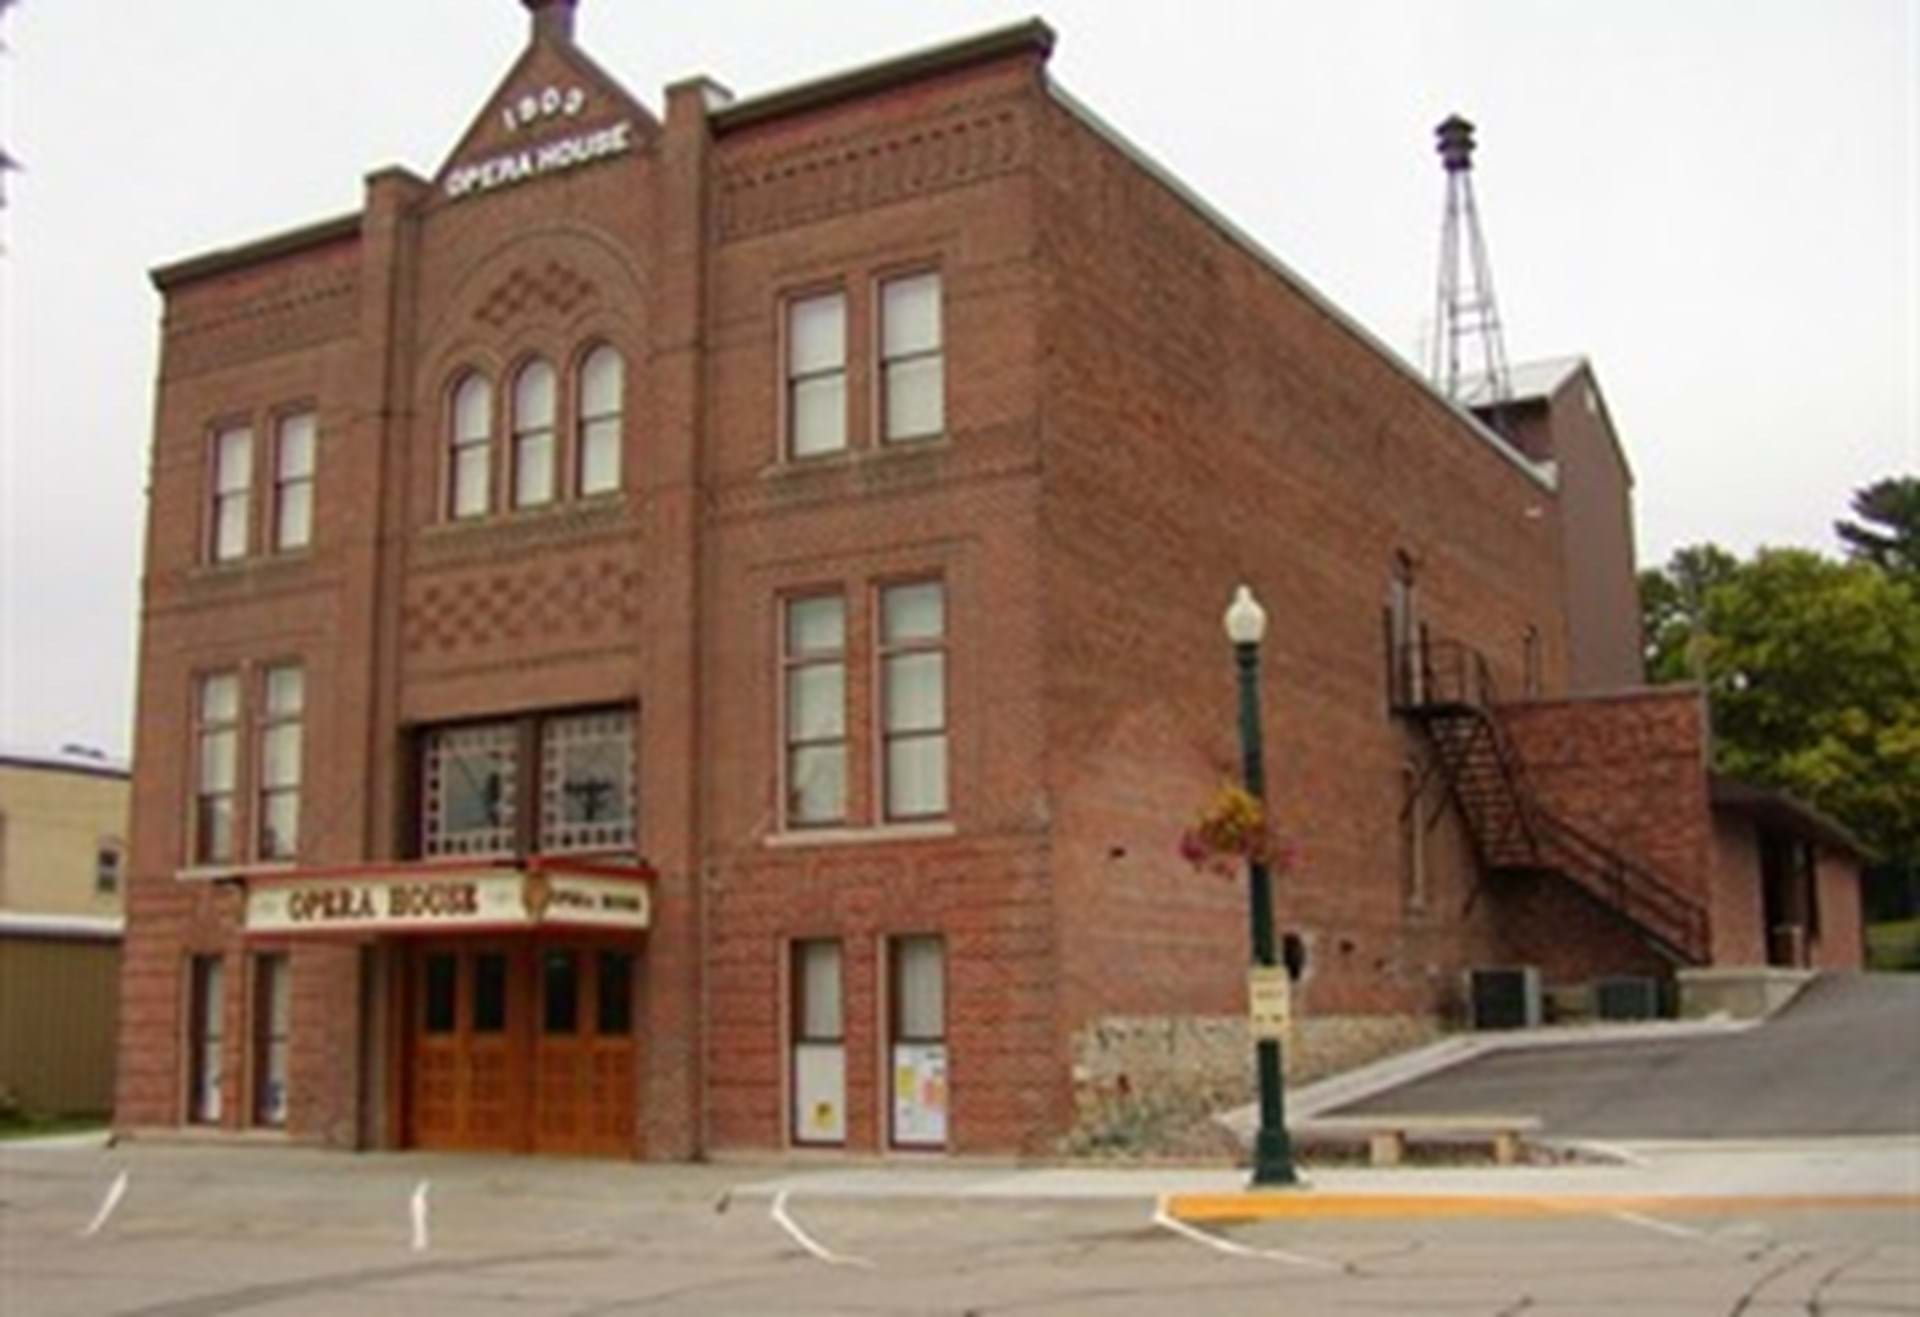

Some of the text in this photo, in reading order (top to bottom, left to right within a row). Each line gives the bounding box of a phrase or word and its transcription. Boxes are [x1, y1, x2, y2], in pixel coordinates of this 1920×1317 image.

[446, 121, 631, 197] OPERA HOUSE
[288, 882, 480, 921] OPERA HOUSE
